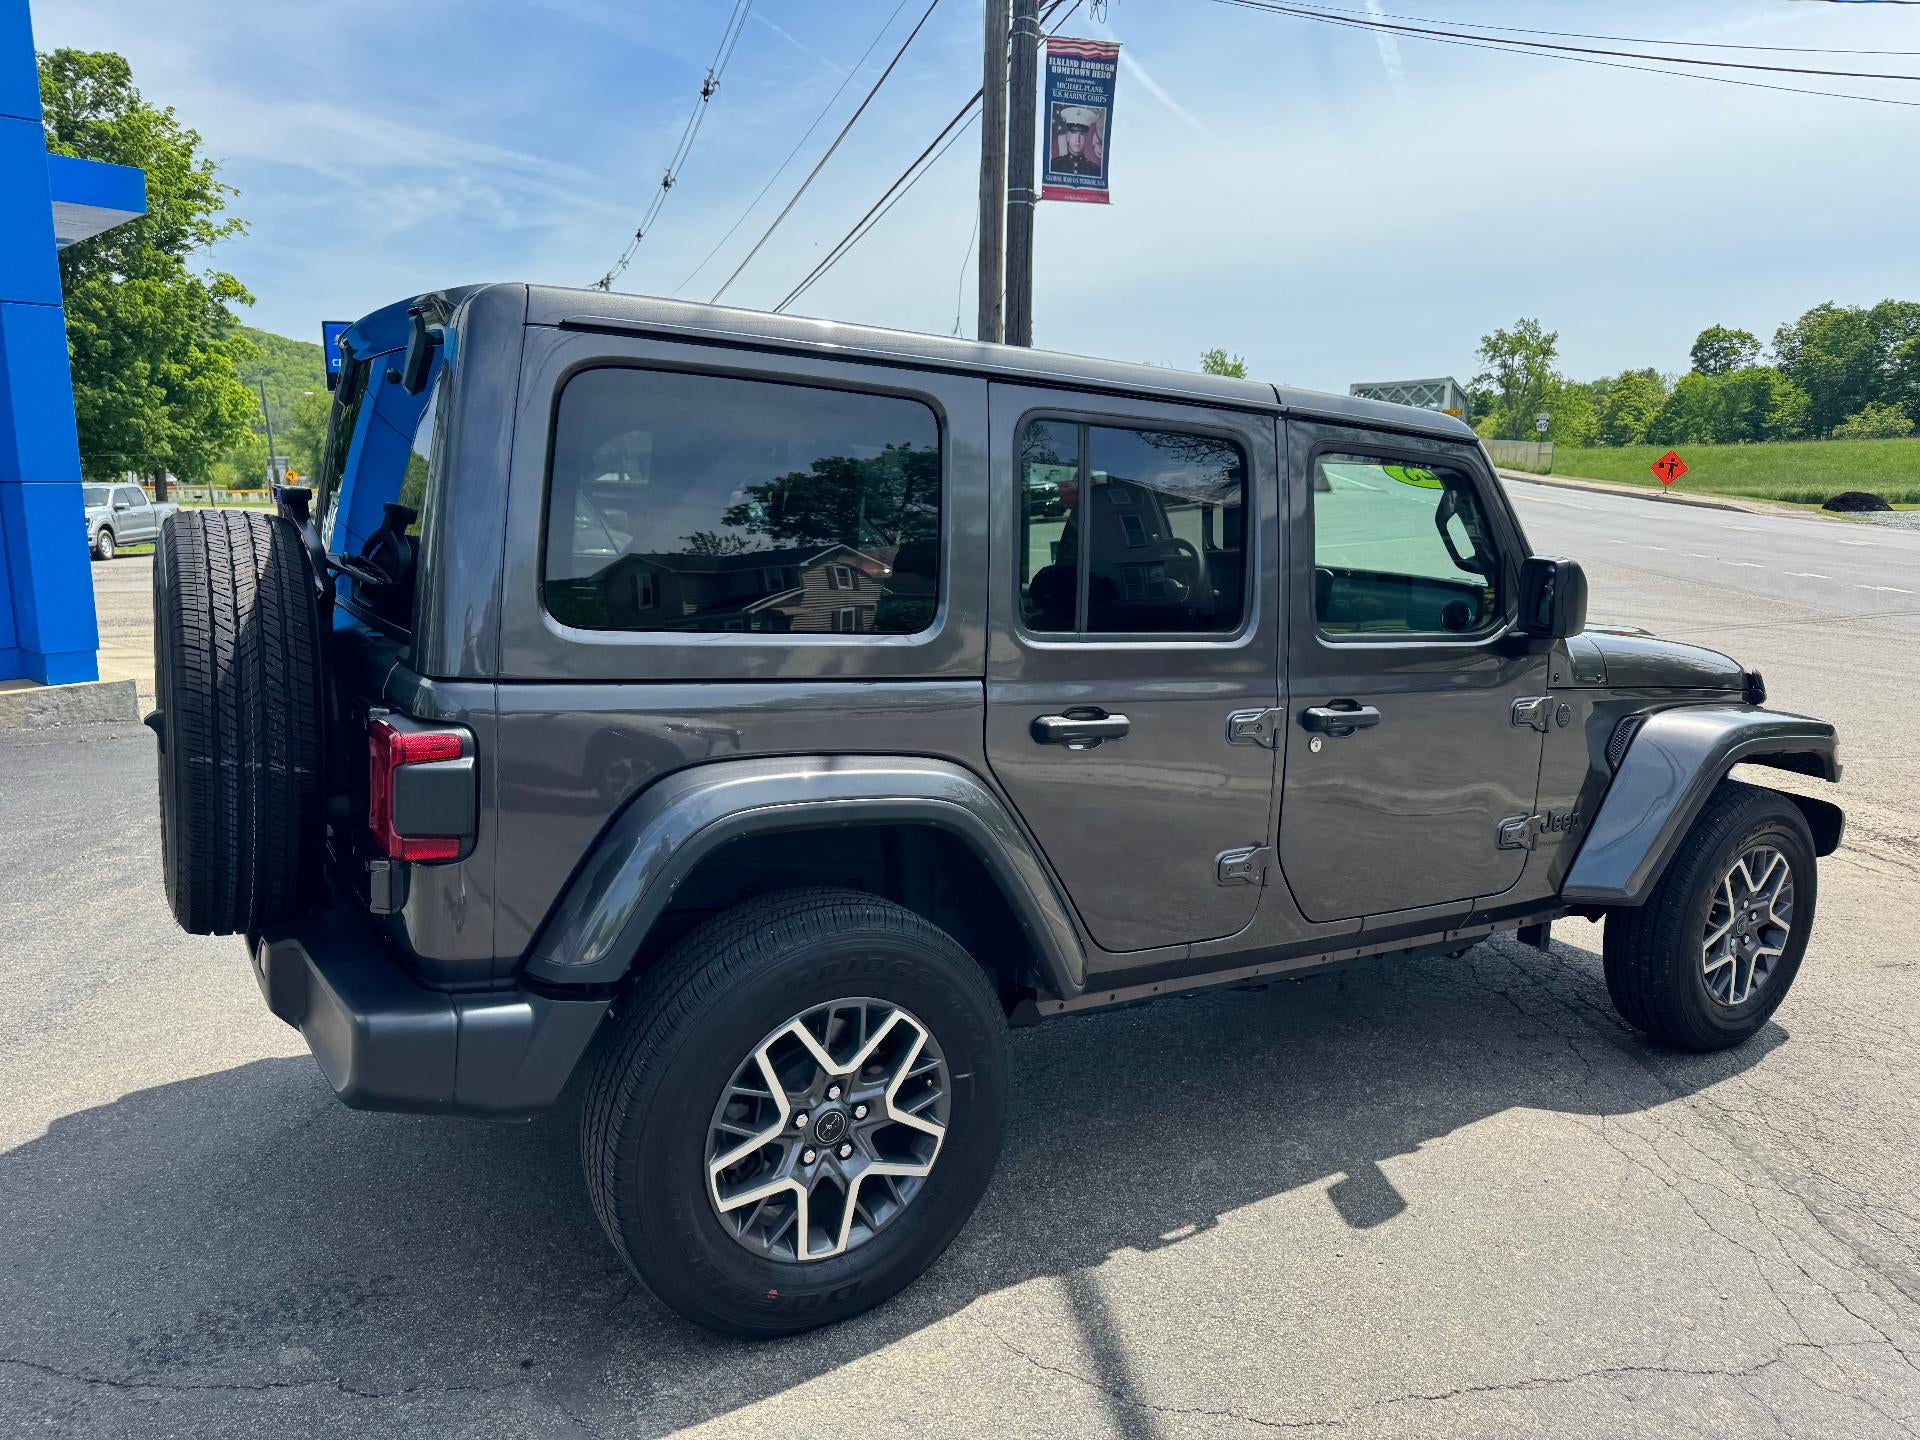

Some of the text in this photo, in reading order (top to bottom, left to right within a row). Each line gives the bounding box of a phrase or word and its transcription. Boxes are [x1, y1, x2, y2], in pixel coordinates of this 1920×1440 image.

[1049, 57, 1115, 72] ELKLAND BOROUGH
[1052, 66, 1111, 79] HOMETOWN HERO
[1057, 82, 1104, 93] MICHAEL PLANK
[1064, 92, 1087, 101] MARINE
[1087, 95, 1107, 103] CORPS
[1540, 810, 1578, 834] Jeep
